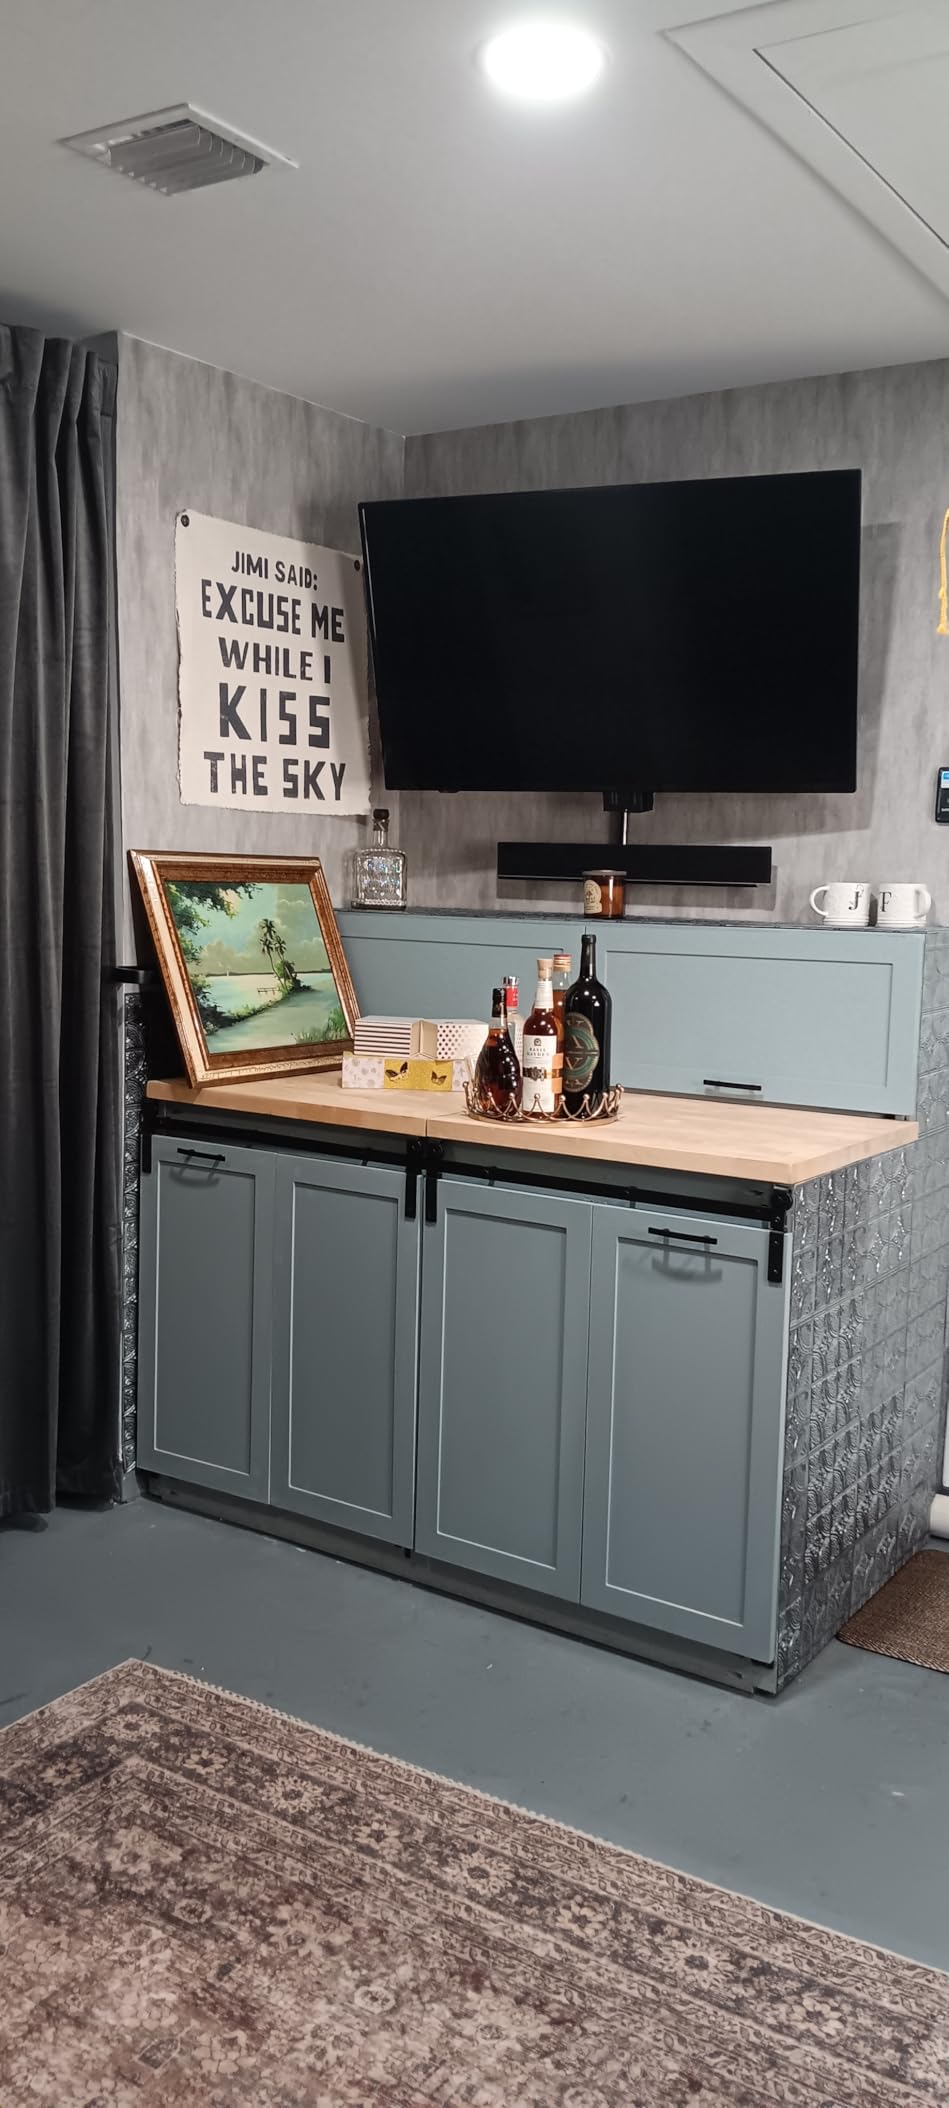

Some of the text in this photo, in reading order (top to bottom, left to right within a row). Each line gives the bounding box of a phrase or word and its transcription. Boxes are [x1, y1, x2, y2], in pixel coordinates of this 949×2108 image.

[231, 551, 318, 592] JIMI SAID:
[201, 578, 345, 643] EXCUSE ME
[218, 636, 331, 685] WHILE I
[219, 682, 331, 749] KISS
[203, 751, 346, 801] THE SKY
[848, 890, 860, 911] J
